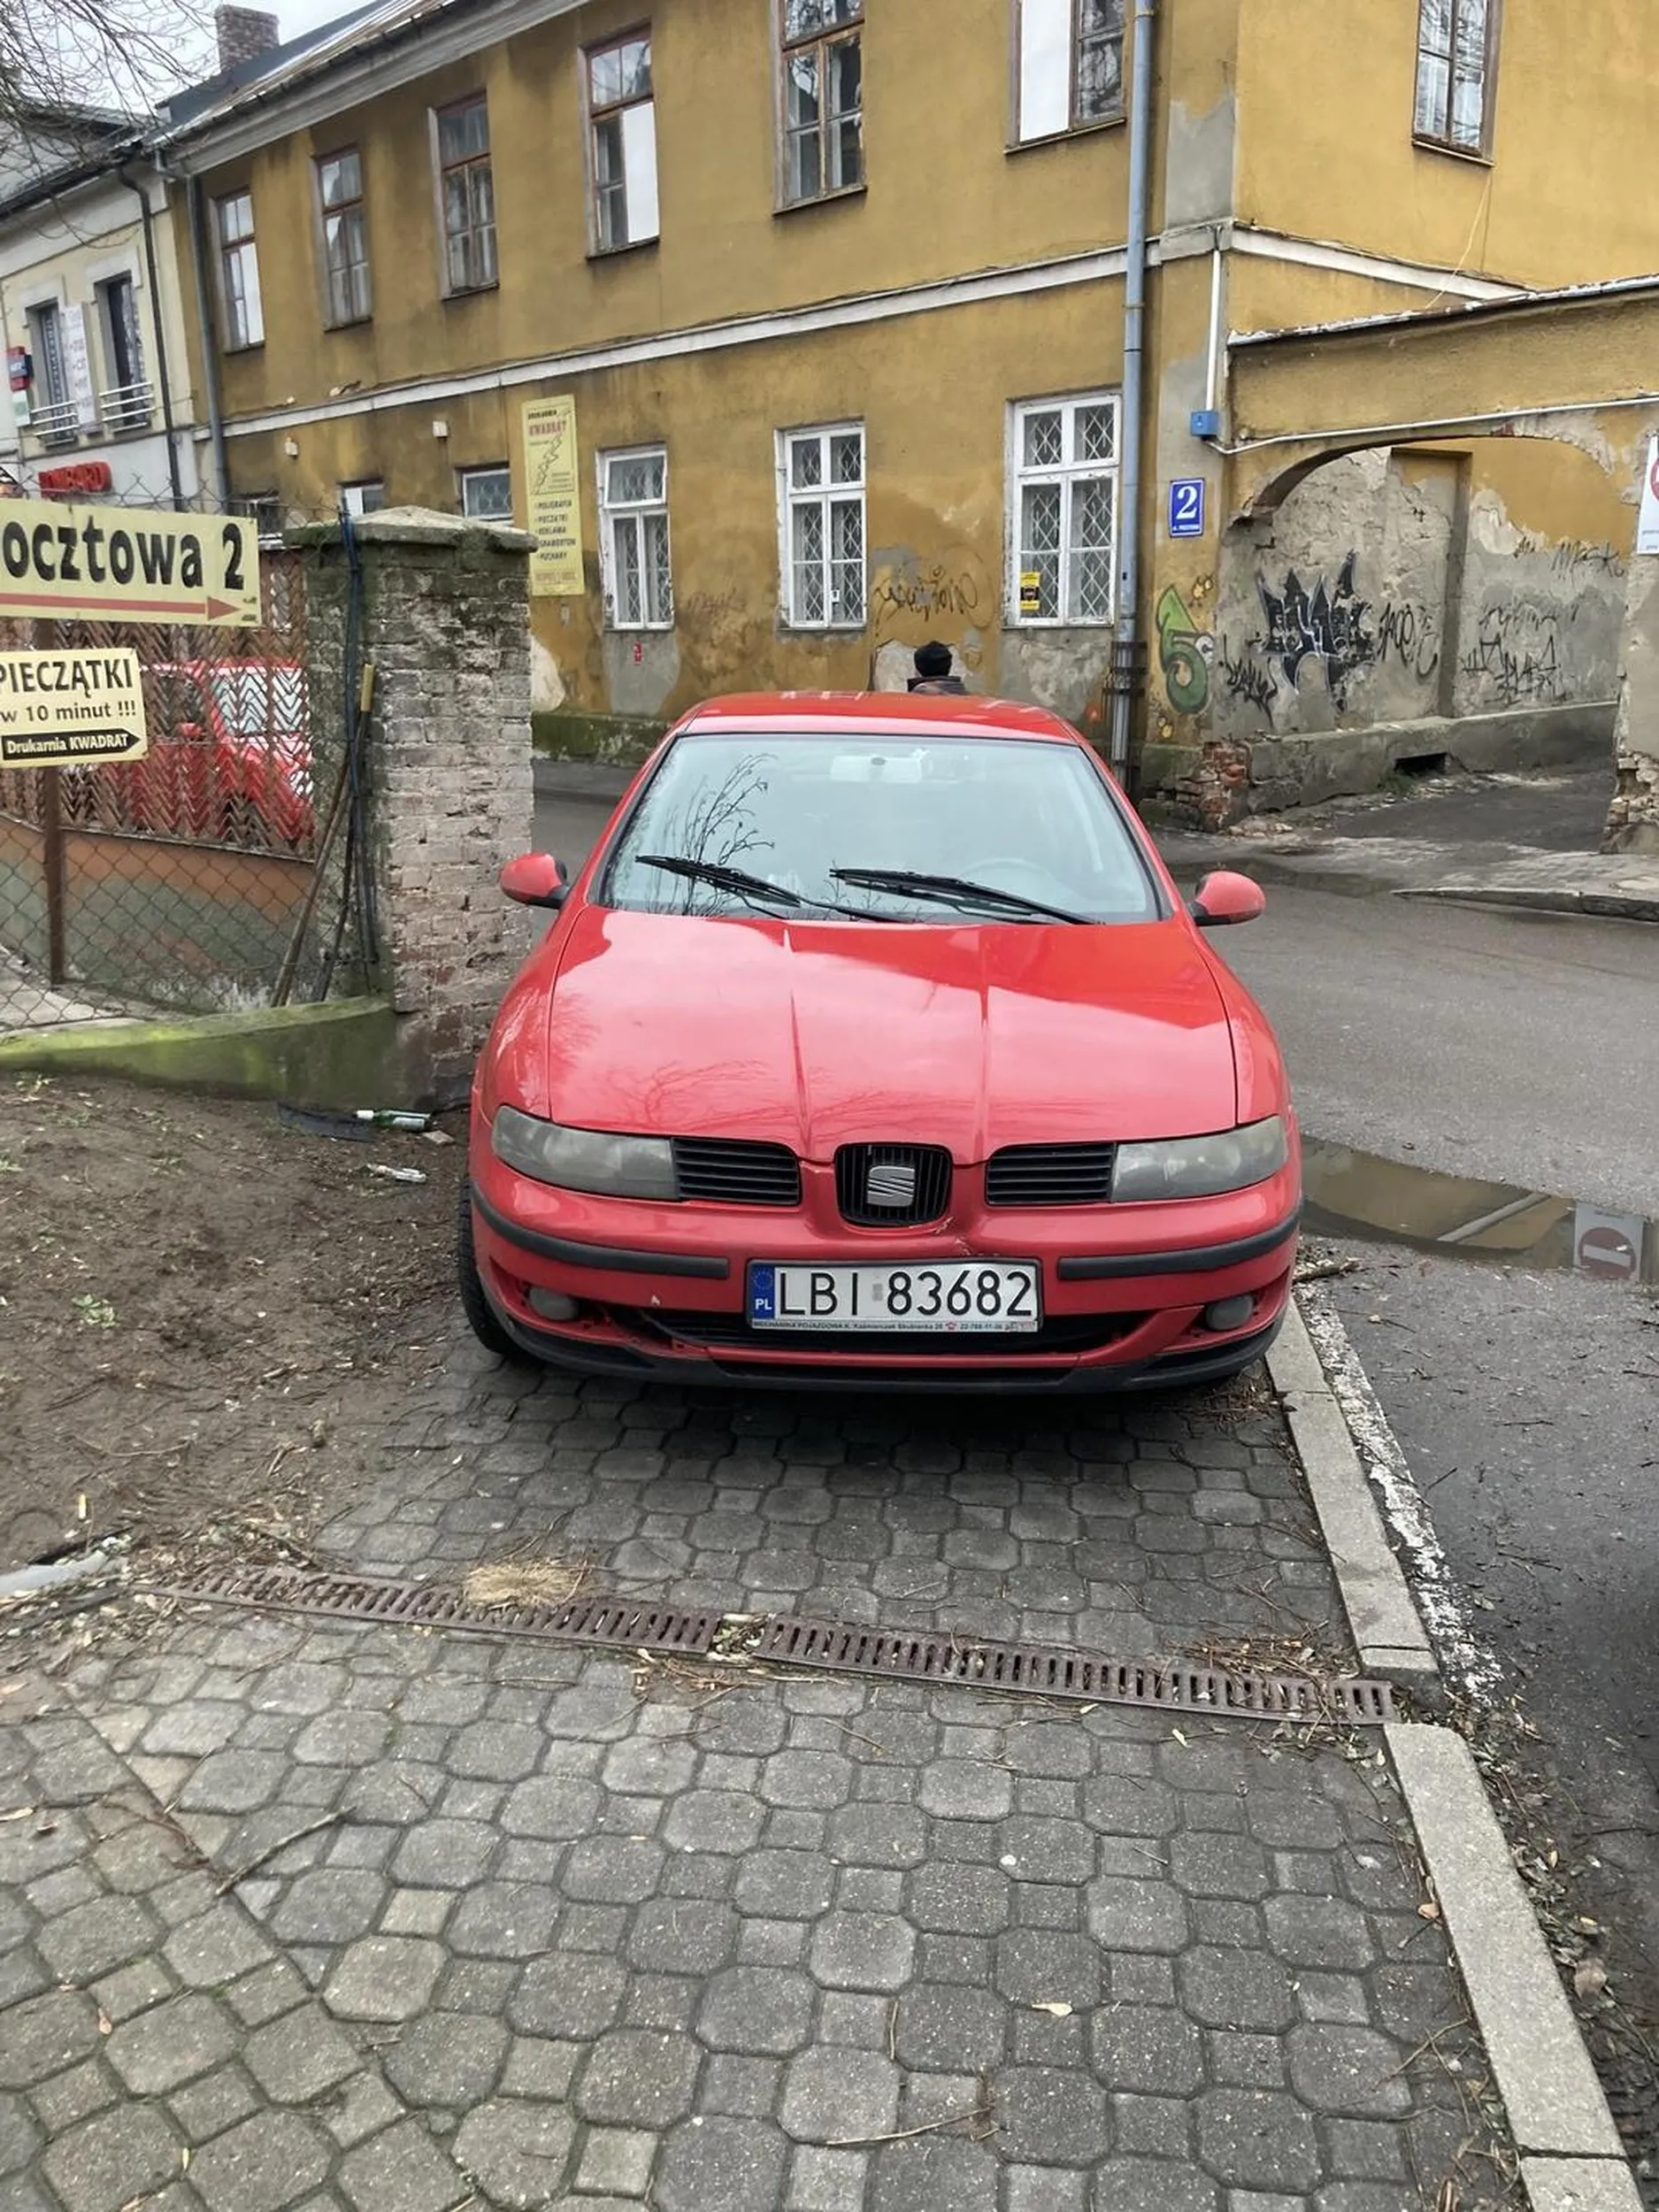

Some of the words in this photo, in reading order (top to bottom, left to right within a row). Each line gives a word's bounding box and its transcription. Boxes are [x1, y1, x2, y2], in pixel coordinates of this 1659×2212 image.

[1176, 486, 1197, 519] 2
[223, 523, 244, 590] 2
[0, 710, 18, 722] w
[27, 705, 49, 721] 10
[56, 703, 111, 720] minut
[118, 701, 136, 716] !!!
[7, 737, 67, 754] Drukarnia
[69, 733, 129, 750] KWADRAT
[755, 1299, 772, 1310] PL
[780, 1272, 858, 1316] LBI
[887, 1270, 1033, 1317] 83682
